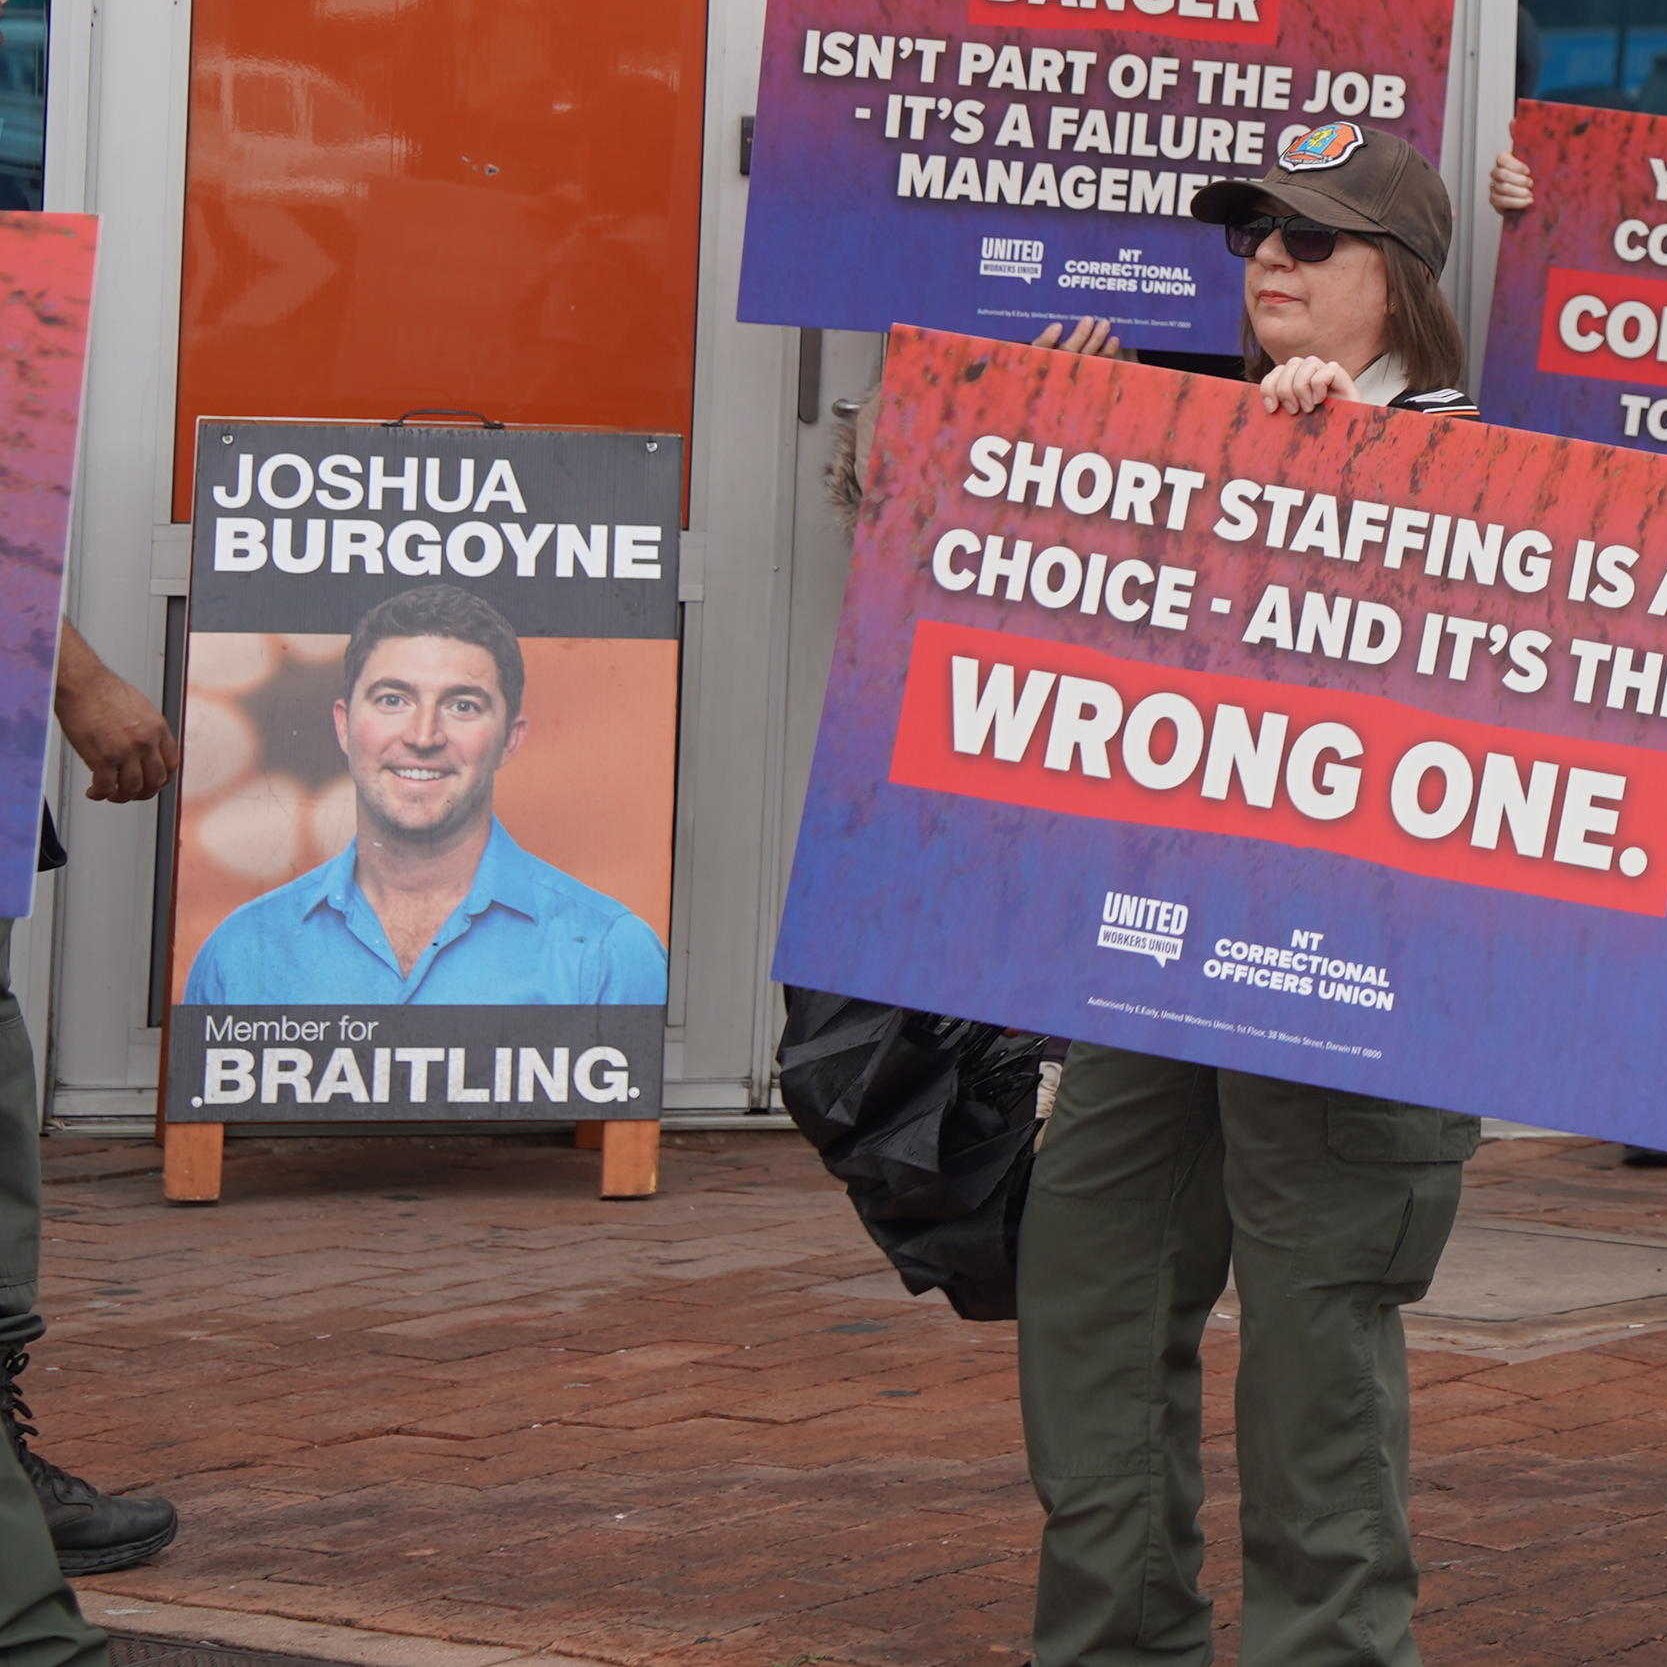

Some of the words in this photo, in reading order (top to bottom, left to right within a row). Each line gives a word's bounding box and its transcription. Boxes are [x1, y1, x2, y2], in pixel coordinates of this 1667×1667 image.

[804, 30, 946, 83] ISN'T
[959, 42, 1097, 94] PART
[1109, 54, 1179, 100] OF
[1193, 60, 1292, 110] THE
[1303, 70, 1405, 118] JOB
[885, 94, 985, 144] IT'S
[995, 104, 1036, 148] A
[1048, 107, 1265, 164] FAILURE
[981, 237, 1044, 262] UNITED
[983, 263, 1016, 274] WORKERS
[1017, 266, 1039, 275] UNION
[1064, 260, 1192, 281] CORRECTIONAL
[1119, 249, 1142, 262] NT
[1058, 275, 1137, 292] OFFICERS
[1141, 281, 1196, 296] UNION
[213, 454, 526, 513] JOSHUA
[964, 436, 1205, 530] SHORT
[1213, 479, 1552, 592] STAFFING
[1568, 540, 1639, 608] IS
[215, 518, 661, 579] BURGOYNE
[933, 529, 1196, 630] CHOICE
[1242, 585, 1401, 664] AND
[1417, 613, 1552, 692] IT'S
[952, 656, 1363, 819] WRONG
[1391, 742, 1647, 876] ONE.
[1103, 892, 1189, 935] UNITED
[1103, 930, 1146, 950] WORKERS
[1149, 939, 1178, 955] UNION
[1215, 939, 1390, 987] CORRECTIONAL
[1291, 929, 1324, 951] NT
[1203, 959, 1313, 996] OFFICERS
[1318, 980, 1394, 1011] UNION
[206, 1016, 330, 1041] Member
[339, 1015, 379, 1041] for
[1161, 1009, 1183, 1022] United
[1184, 1014, 1212, 1027] Workers
[1325, 1041, 1350, 1054] Darwin
[1350, 1046, 1361, 1056] NT
[204, 1047, 630, 1103] BRAITLING
